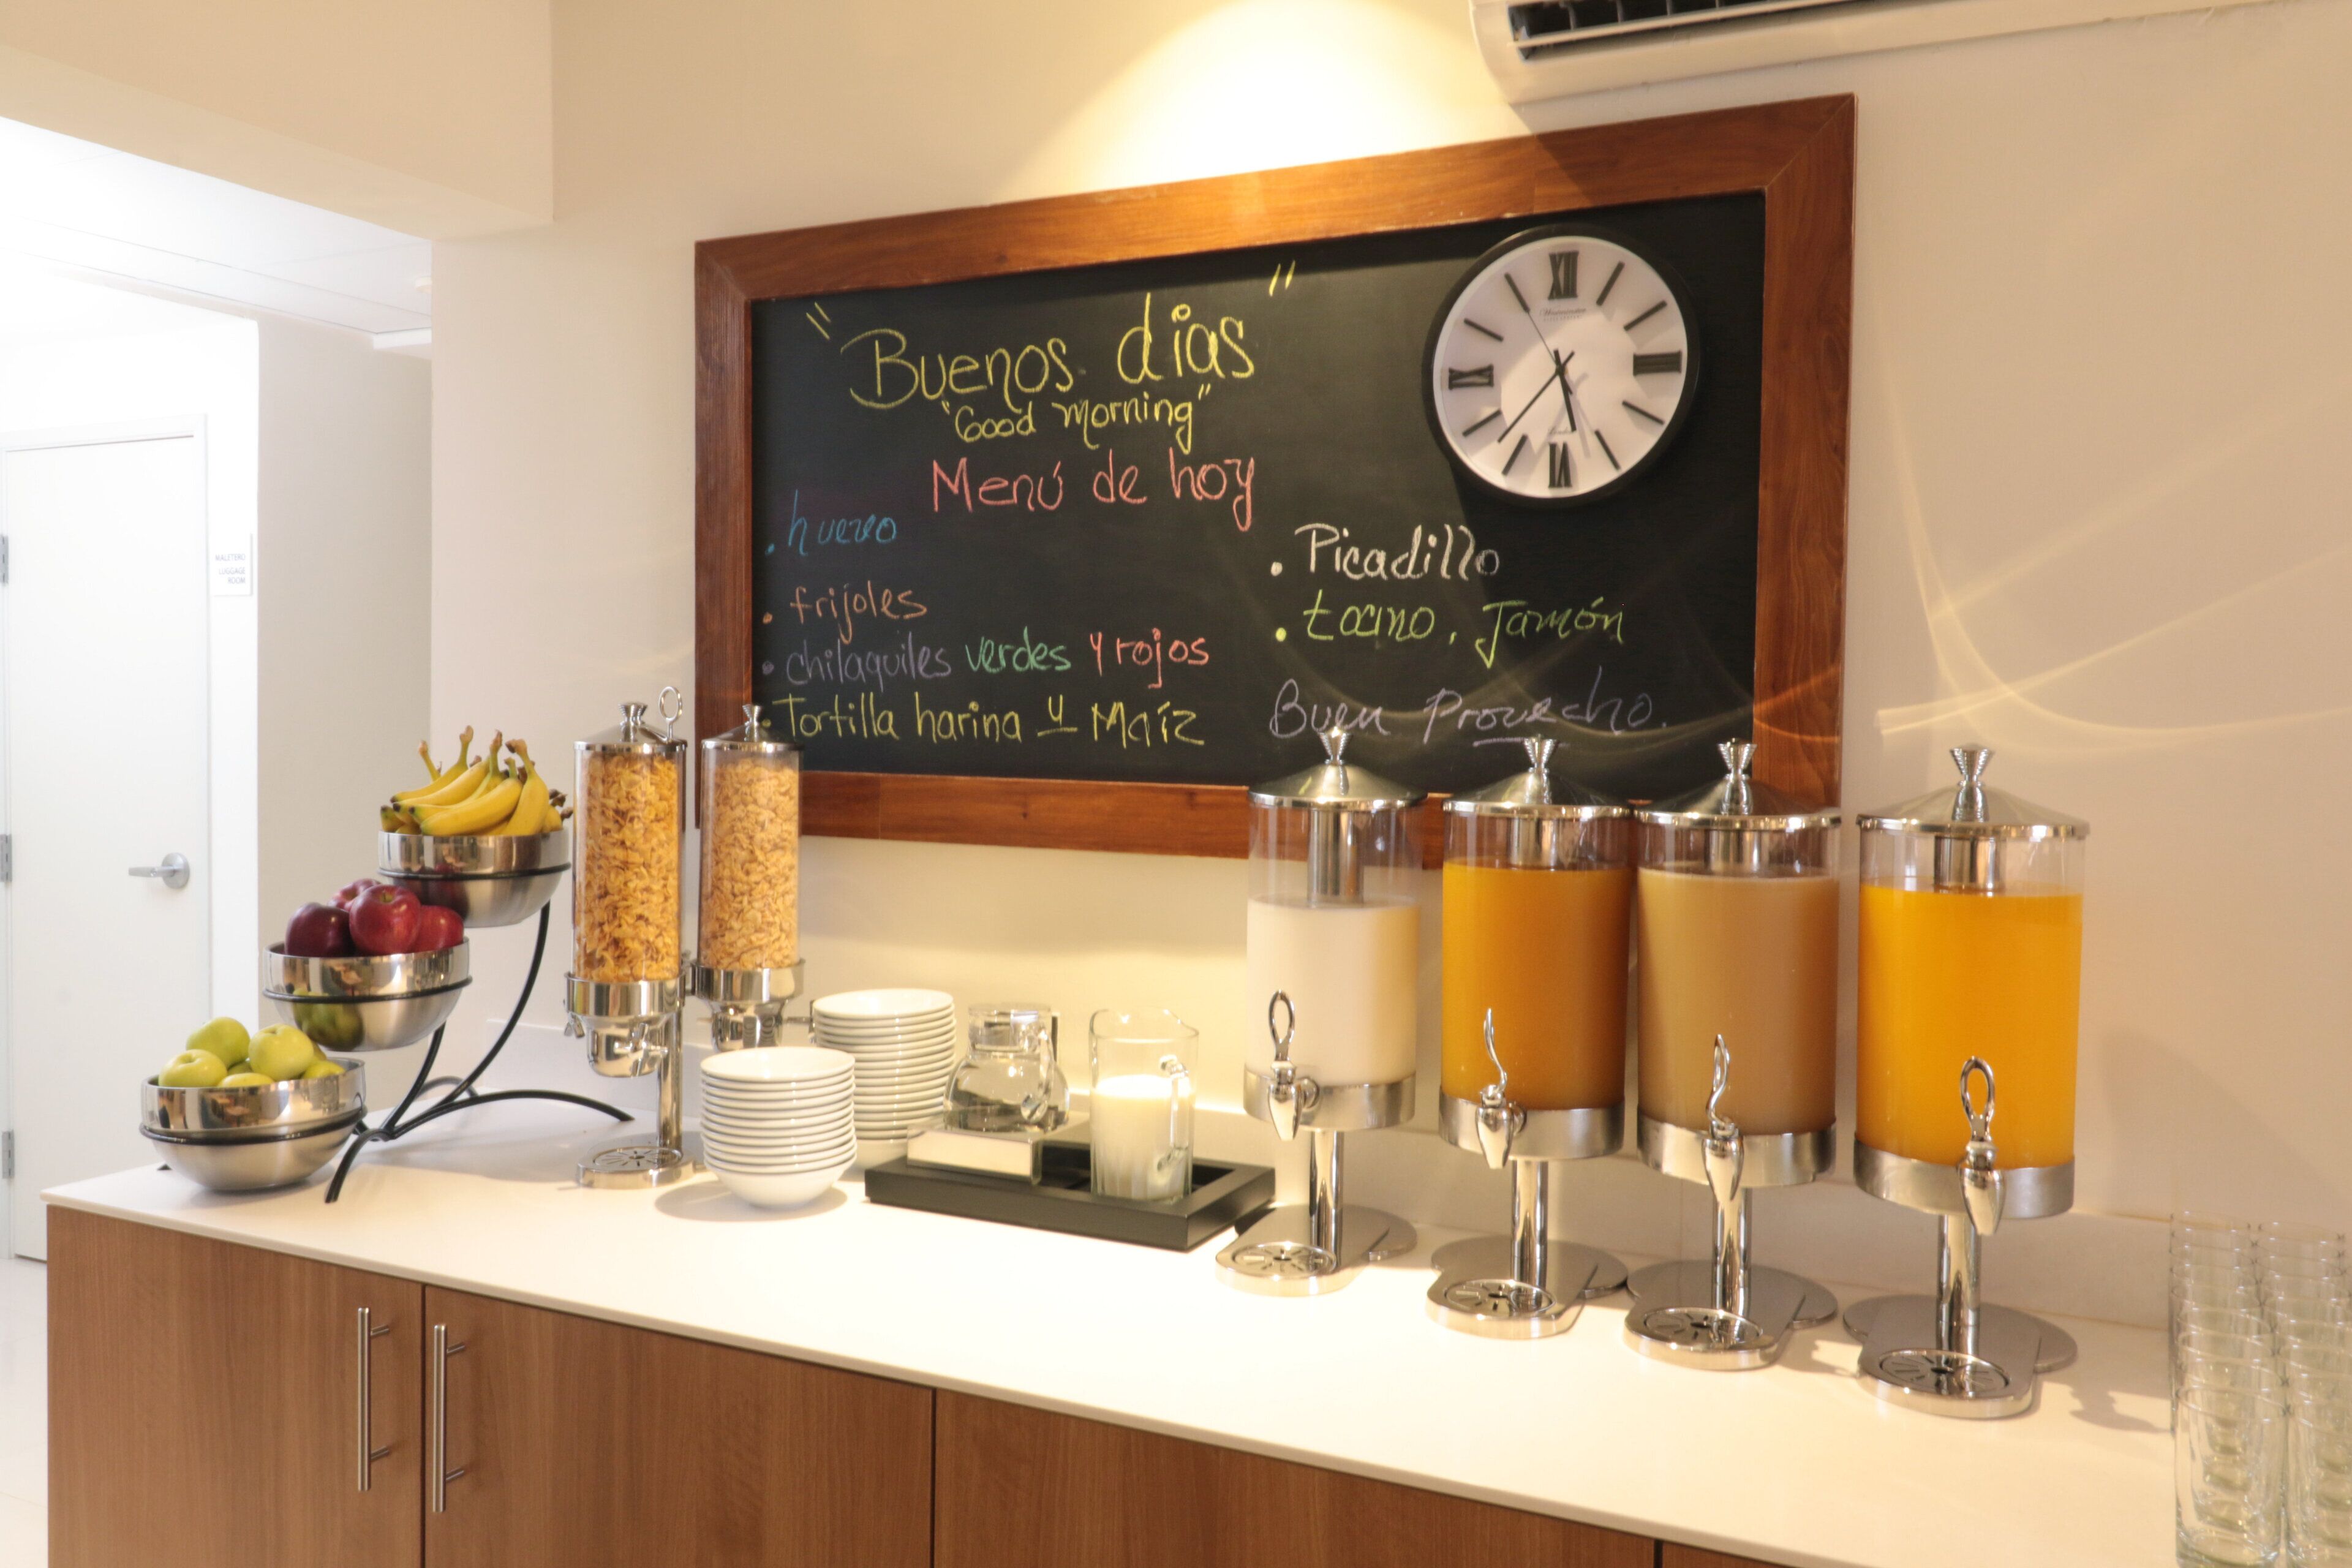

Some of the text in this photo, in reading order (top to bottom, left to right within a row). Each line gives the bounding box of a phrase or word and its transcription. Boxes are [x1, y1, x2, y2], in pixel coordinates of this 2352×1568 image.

[933, 447, 1254, 532] Menú de hoy
[1295, 523, 1500, 581] Picadillo
[790, 581, 927, 644] frijoles
[1475, 597, 1624, 669] Jamón
[786, 631, 951, 692] chilaquiles
[966, 627, 1072, 674] verdes
[1116, 628, 1210, 688] rojos
[772, 692, 900, 740] Tortilla
[915, 692, 1022, 742] harina
[1091, 701, 1205, 748] Maíz
[1270, 679, 1391, 739] Buen
